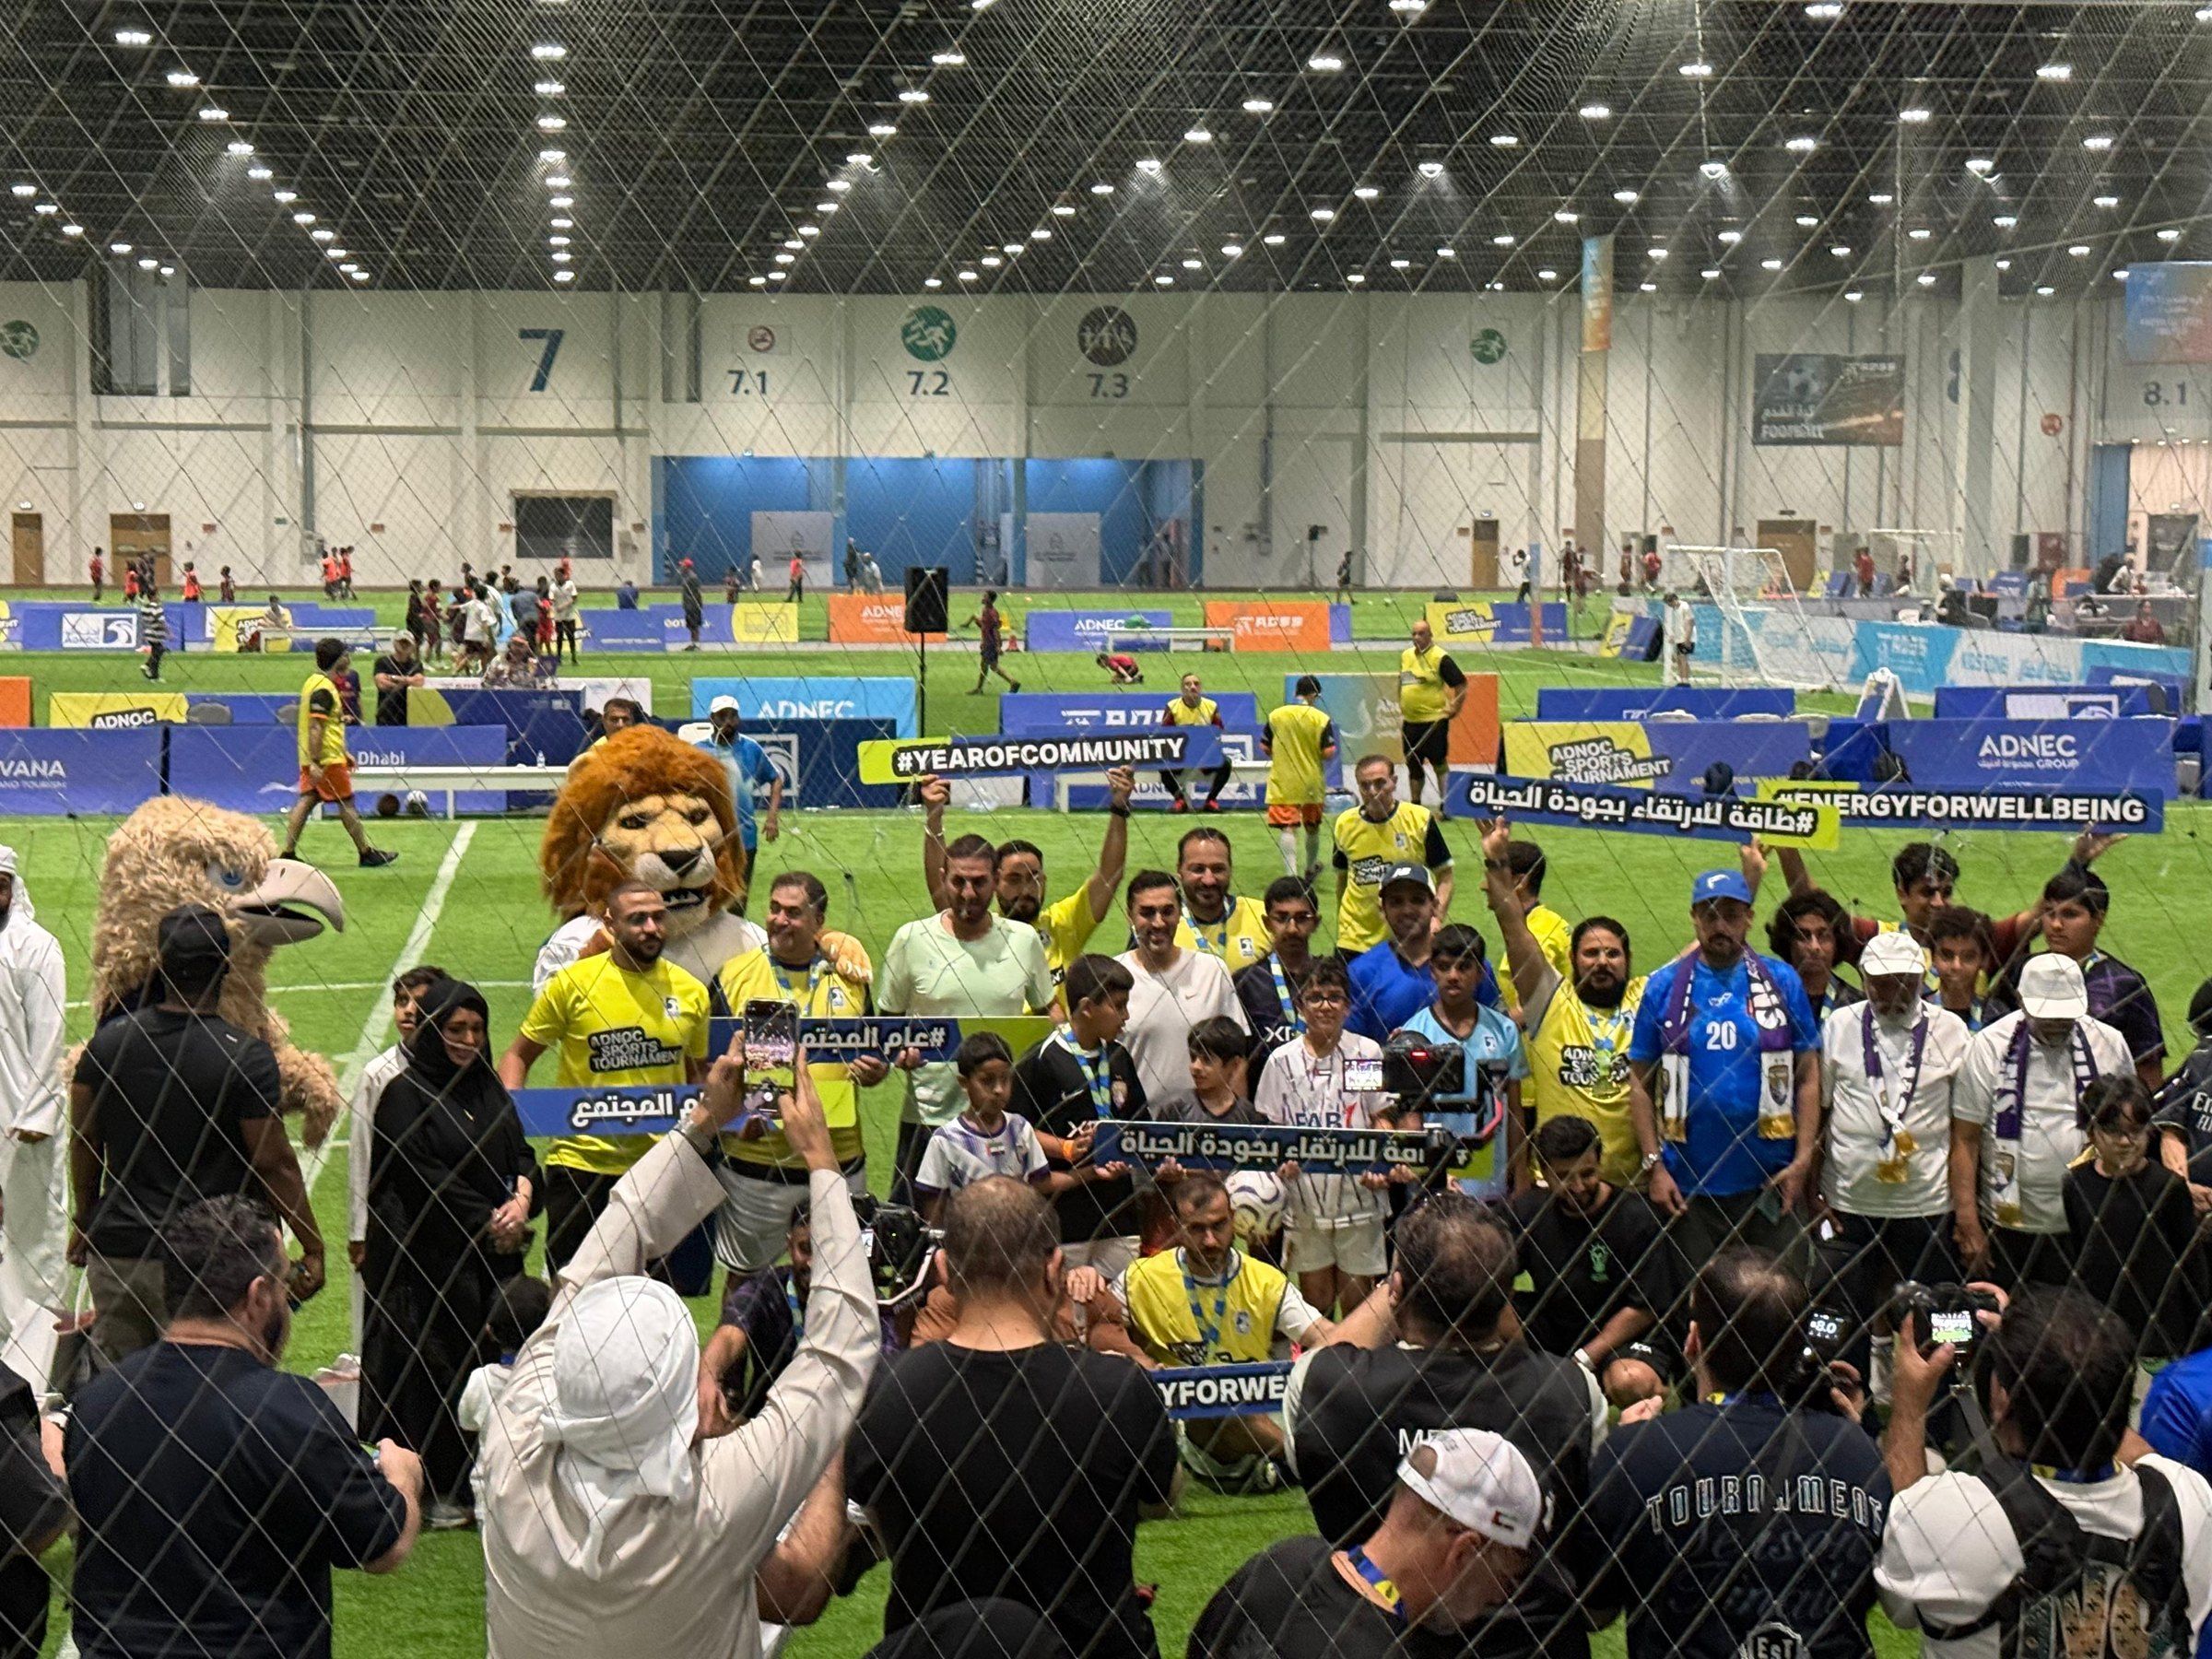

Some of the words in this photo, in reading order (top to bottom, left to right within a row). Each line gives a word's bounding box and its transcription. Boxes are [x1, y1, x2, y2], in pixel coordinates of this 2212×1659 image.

[518, 328, 564, 393] 7
[727, 370, 767, 394] 7.1
[907, 371, 949, 396] 7.2
[1087, 373, 1129, 398] 7.3
[2144, 381, 2186, 406] 8.1
[862, 605, 904, 618] ADNE
[94, 711, 156, 729] ADNOC
[357, 750, 405, 766] Dhabi
[897, 737, 1184, 772] #YEAROFCOMMUNITY
[1551, 740, 1613, 762] ADNOC
[1979, 735, 2077, 758] ADNEC
[1564, 751, 1634, 774] SPORTS
[1470, 782, 1542, 811] الحياة
[1548, 788, 1626, 821] بجودة
[591, 1030, 643, 1049] ADNOC
[801, 1026, 878, 1054] المجتم
[883, 1026, 947, 1056] #عام
[1706, 1020, 1737, 1051] 20
[591, 1049, 681, 1070] TOURNAMEN
[600, 1040, 658, 1059] SPORTS
[571, 1092, 674, 1128] المجتمع
[1120, 1130, 1194, 1156] الحياة
[1200, 1132, 1281, 1163] بجودة
[1157, 1373, 1292, 1407] YFORWE
